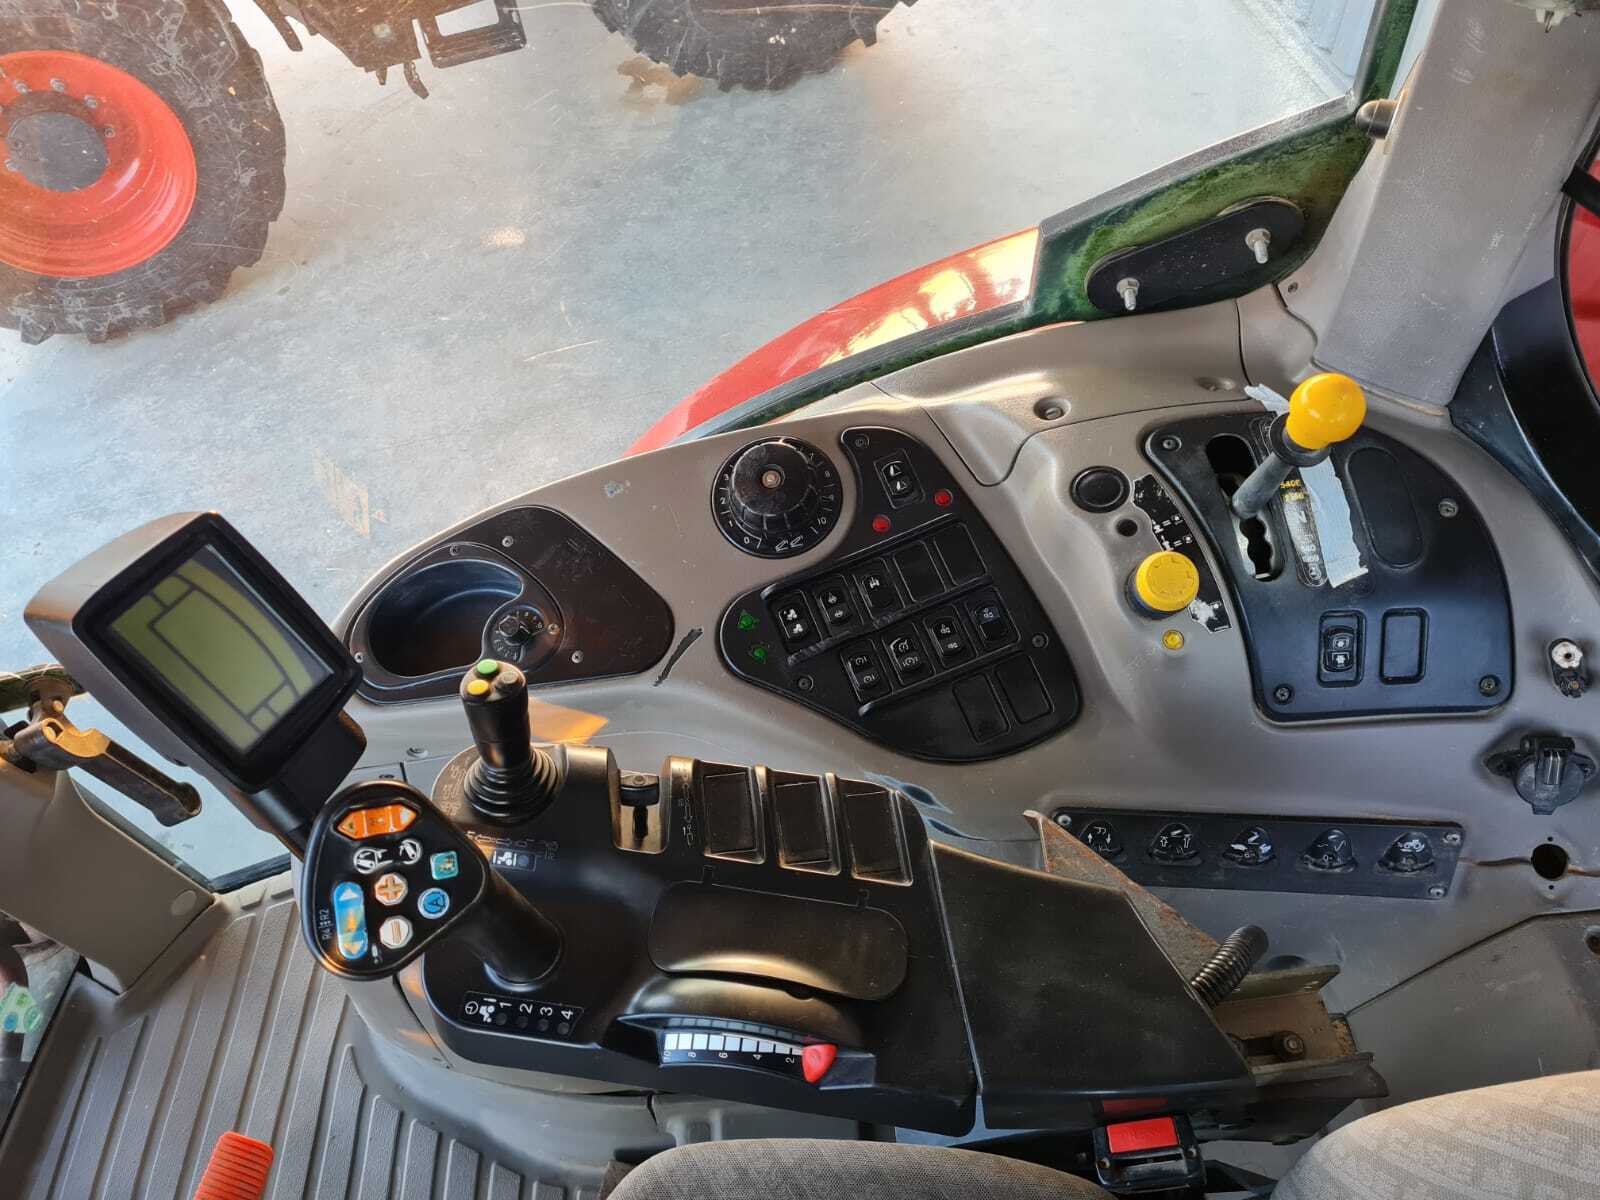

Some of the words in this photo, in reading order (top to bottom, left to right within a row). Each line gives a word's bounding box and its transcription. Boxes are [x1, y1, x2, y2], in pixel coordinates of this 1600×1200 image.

[817, 517, 827, 525] 10
[743, 536, 750, 544] 0
[519, 1003, 533, 1014] 2
[540, 1006, 553, 1016] 3
[561, 1009, 573, 1020] 4
[663, 1050, 672, 1063] 10
[718, 1051, 729, 1059] 6
